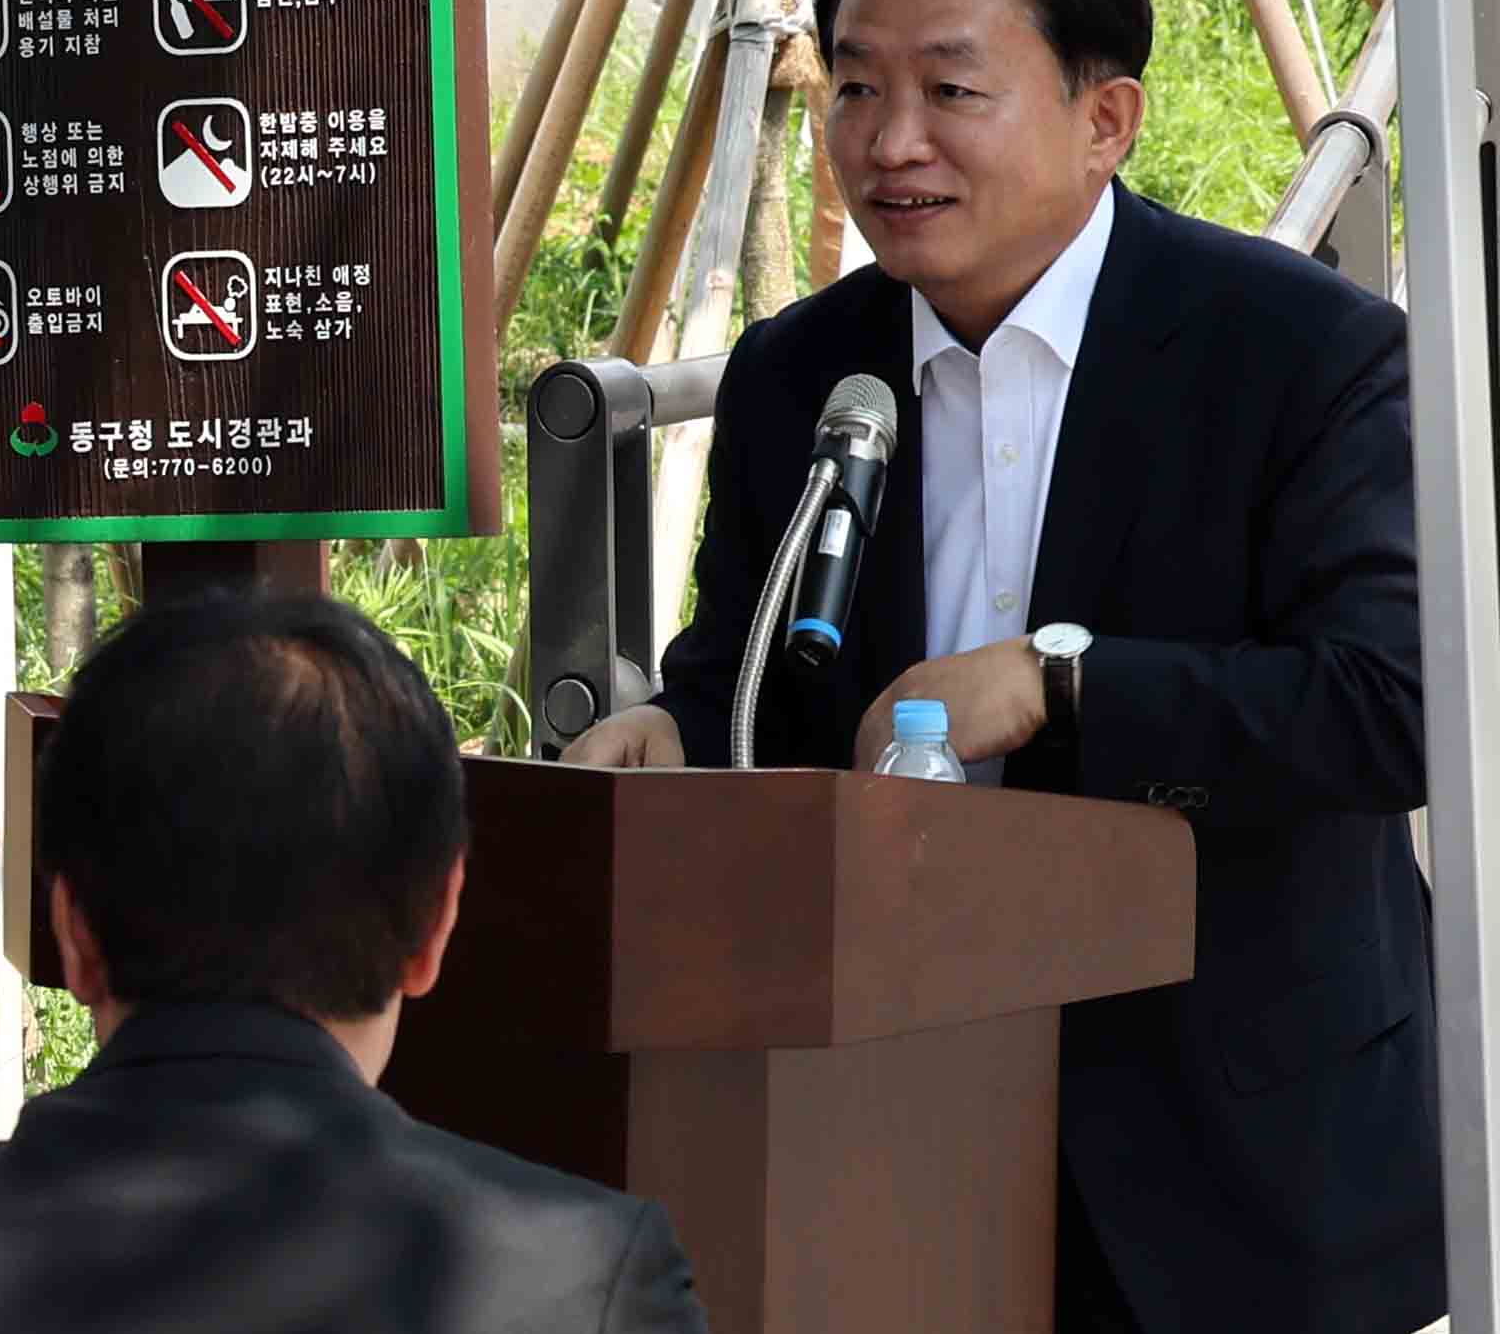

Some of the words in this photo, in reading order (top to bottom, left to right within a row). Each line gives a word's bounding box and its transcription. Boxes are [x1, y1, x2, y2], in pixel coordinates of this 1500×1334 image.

[18, 9, 73, 31] 배설물
[83, 6, 118, 28] 처리
[19, 35, 54, 58] 용기
[65, 33, 101, 56] 지참
[21, 121, 58, 144] 행상
[67, 120, 103, 141] 또는
[327, 107, 387, 132] 이용을
[22, 147, 77, 169] 노점에
[87, 145, 124, 167] 의한
[259, 137, 318, 161] 자제해
[327, 135, 389, 159] 주세요
[23, 173, 78, 196] 상행위
[87, 171, 125, 194] 금지
[260, 161, 376, 189] (22시~7시)
[264, 265, 322, 289] 지나친
[332, 263, 371, 287] 애정
[26, 285, 101, 308] 오토바이
[27, 311, 102, 335] 출입금지
[265, 319, 304, 340] 노숙
[313, 317, 352, 340] 삼가
[69, 419, 153, 453] 동구청
[167, 416, 313, 450] 도시경관과
[103, 454, 272, 480] (문의:770-6200)
